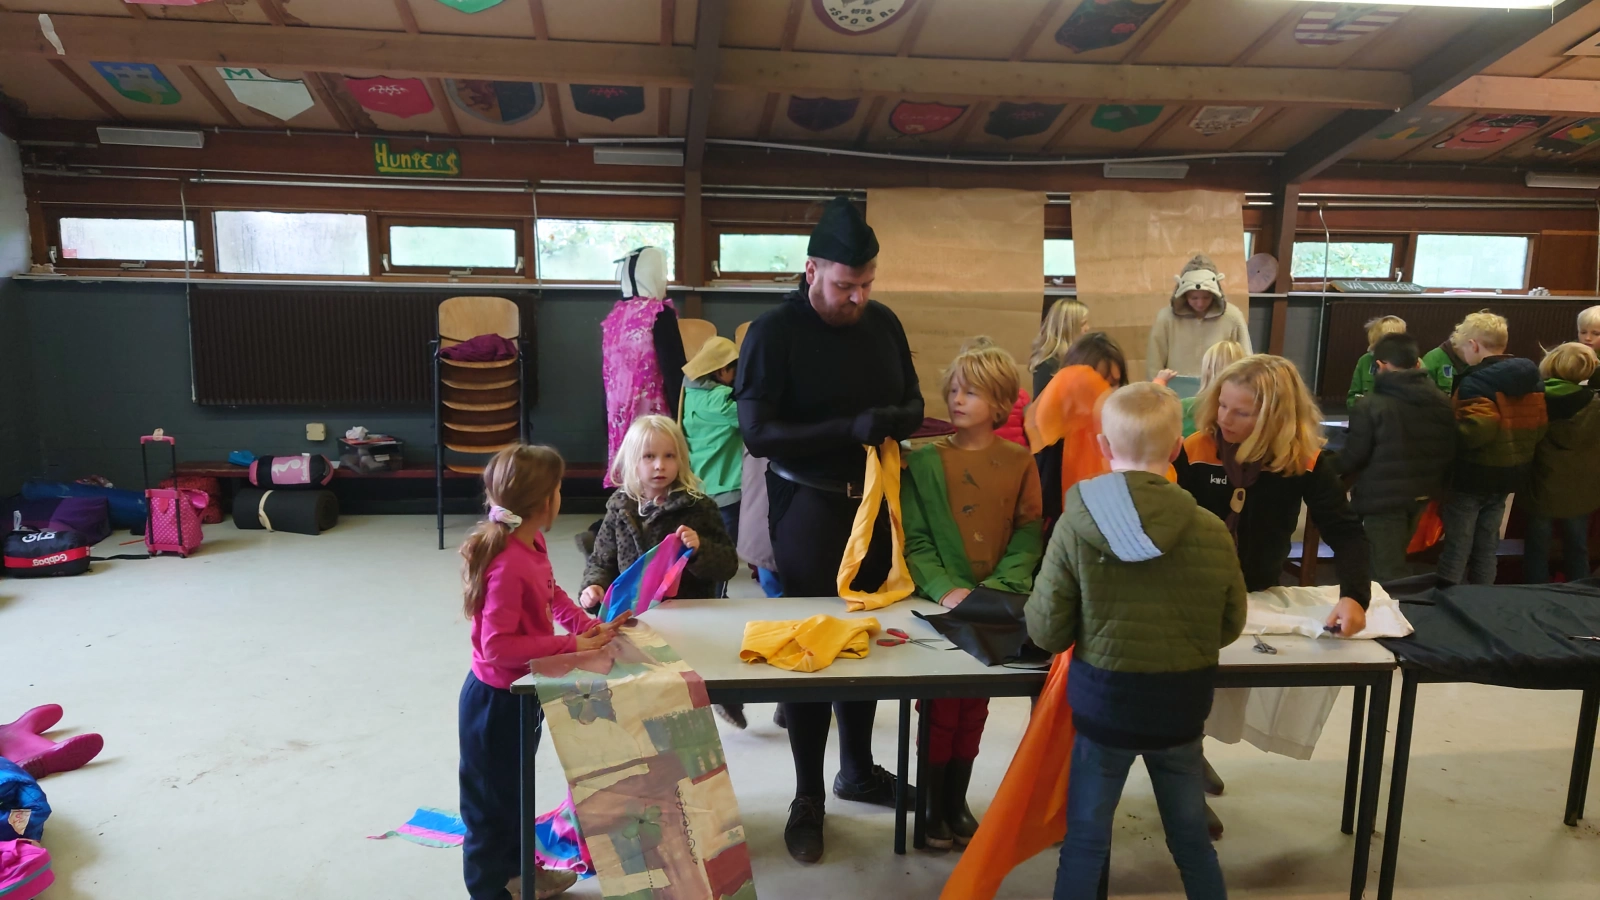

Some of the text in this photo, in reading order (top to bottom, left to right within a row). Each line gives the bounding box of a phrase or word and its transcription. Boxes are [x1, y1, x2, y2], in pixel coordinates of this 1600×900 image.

[1342, 281, 1421, 292] VAL THORENS
[32, 553, 68, 567] Gabbag
